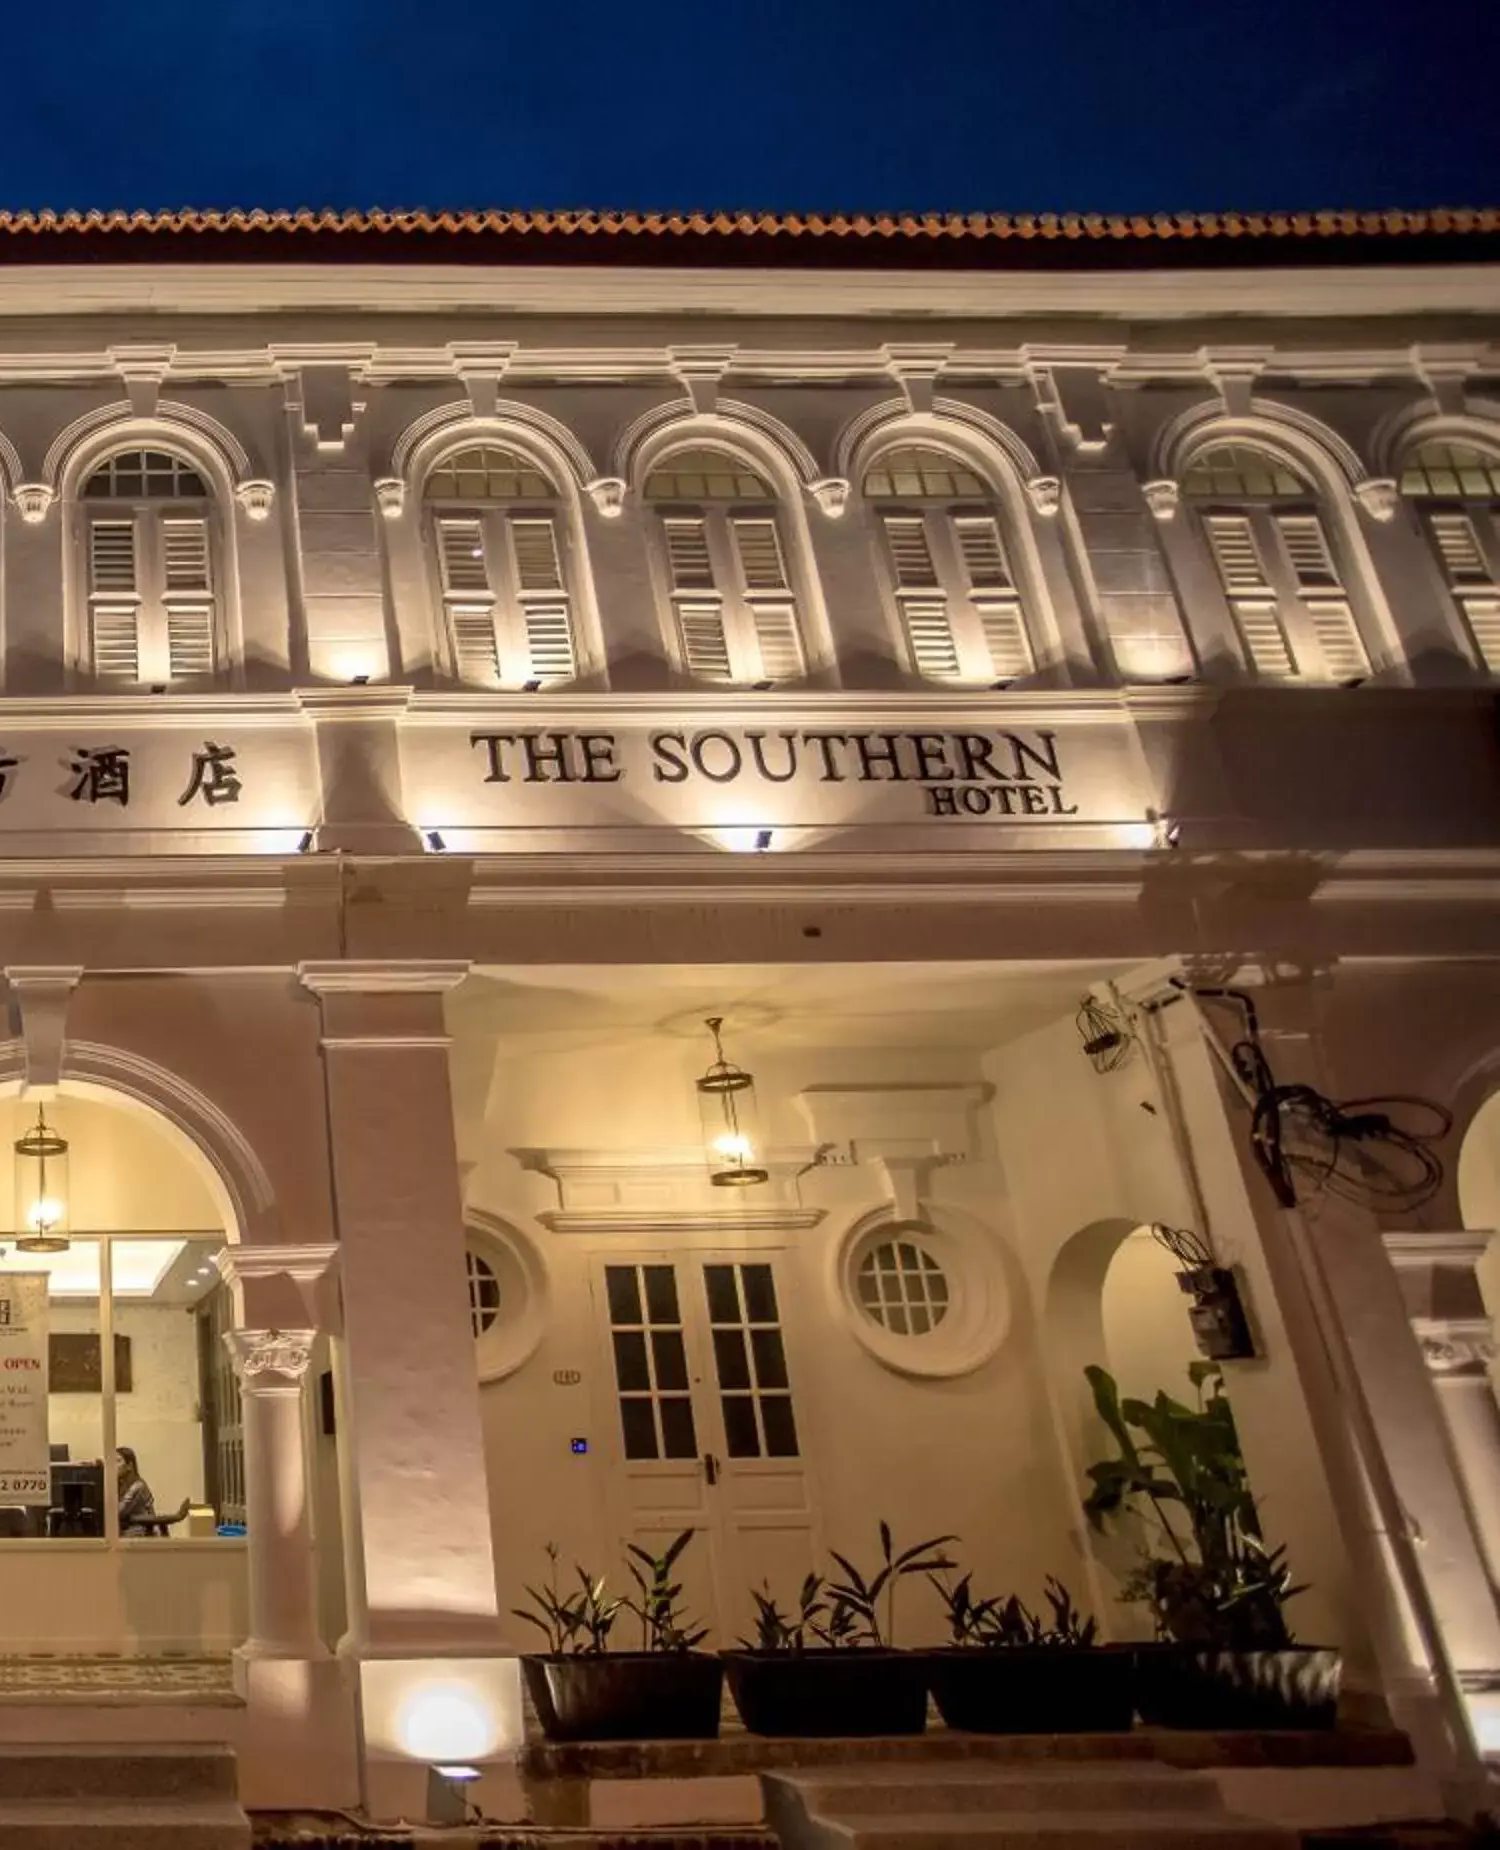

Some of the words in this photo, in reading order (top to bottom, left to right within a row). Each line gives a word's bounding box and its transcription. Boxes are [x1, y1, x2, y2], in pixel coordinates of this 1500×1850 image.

[469, 732, 622, 783] THE
[651, 731, 1063, 784] SOUTHERN
[928, 784, 1079, 816] HOTEL
[4, 1358, 41, 1370] OPEN
[13, 1479, 47, 1492] 0770
